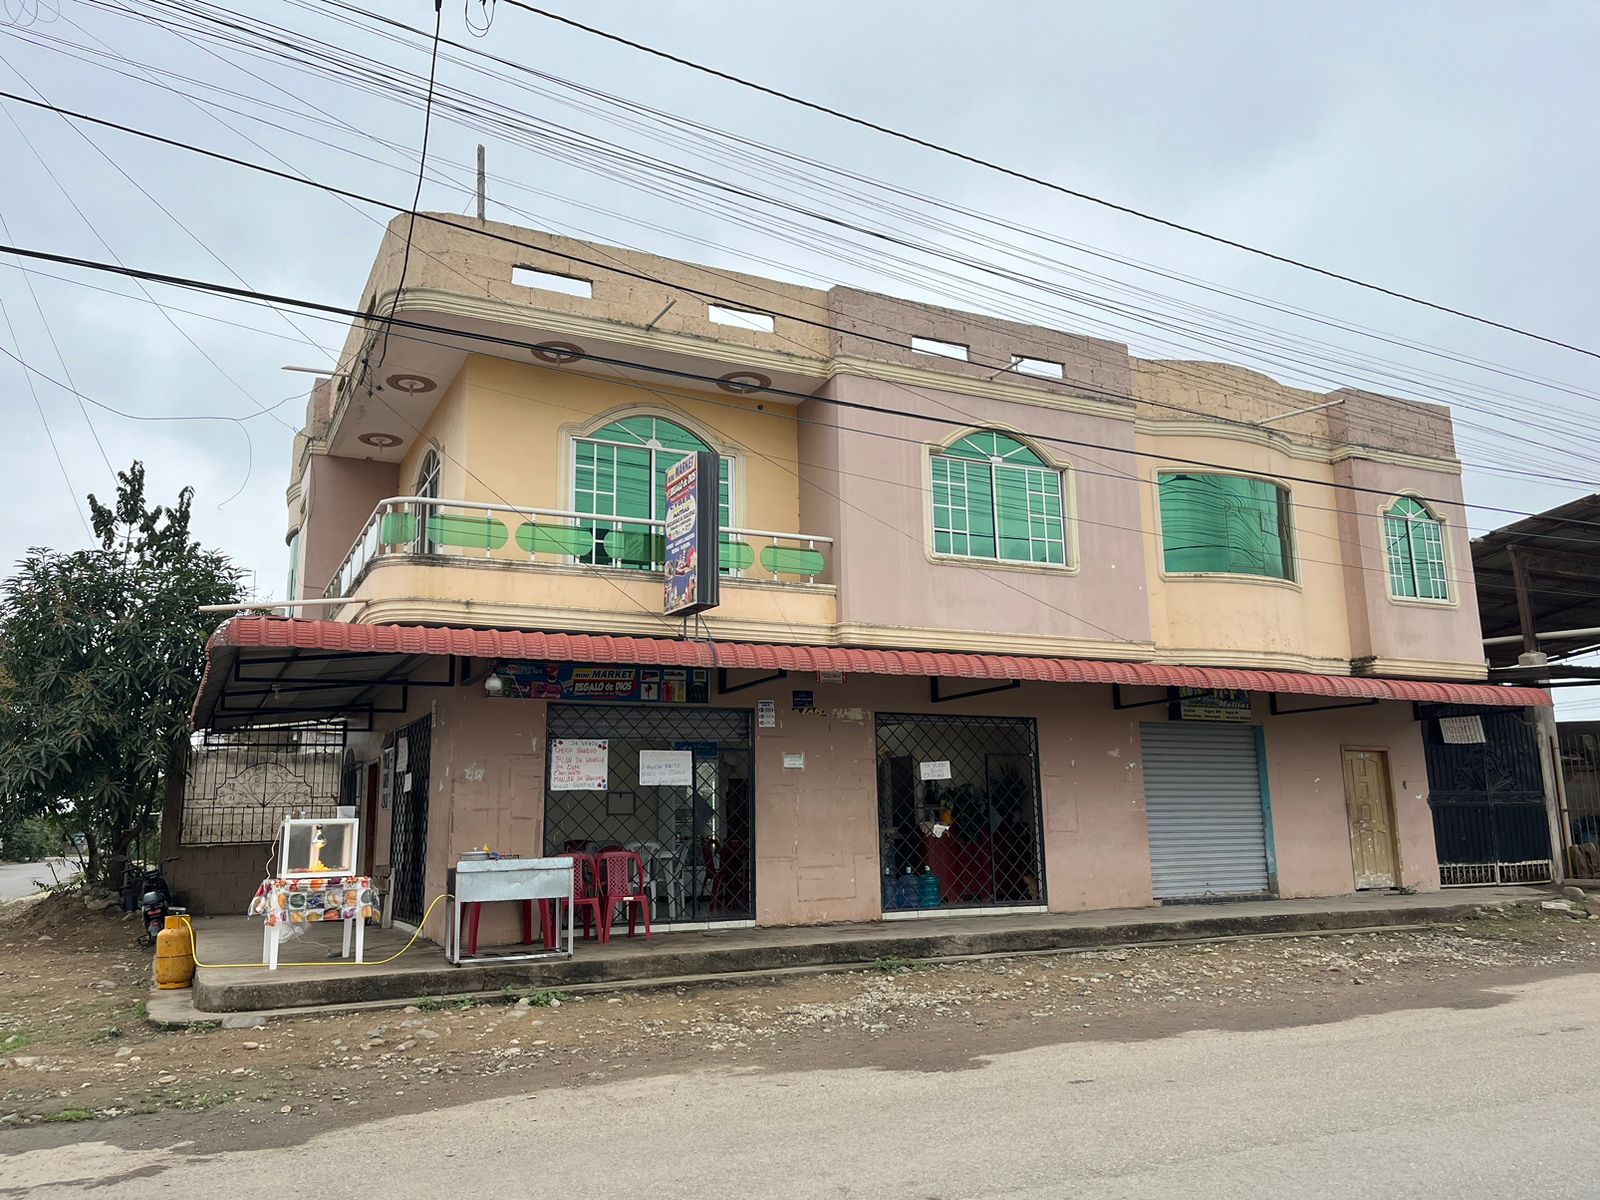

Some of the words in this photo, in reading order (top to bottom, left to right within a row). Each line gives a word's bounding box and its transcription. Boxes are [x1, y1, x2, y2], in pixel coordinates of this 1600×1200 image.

[592, 670, 634, 679] MARKET
[574, 681, 604, 692] REGALO
[605, 682, 614, 691] de
[615, 681, 632, 691] DIOS
